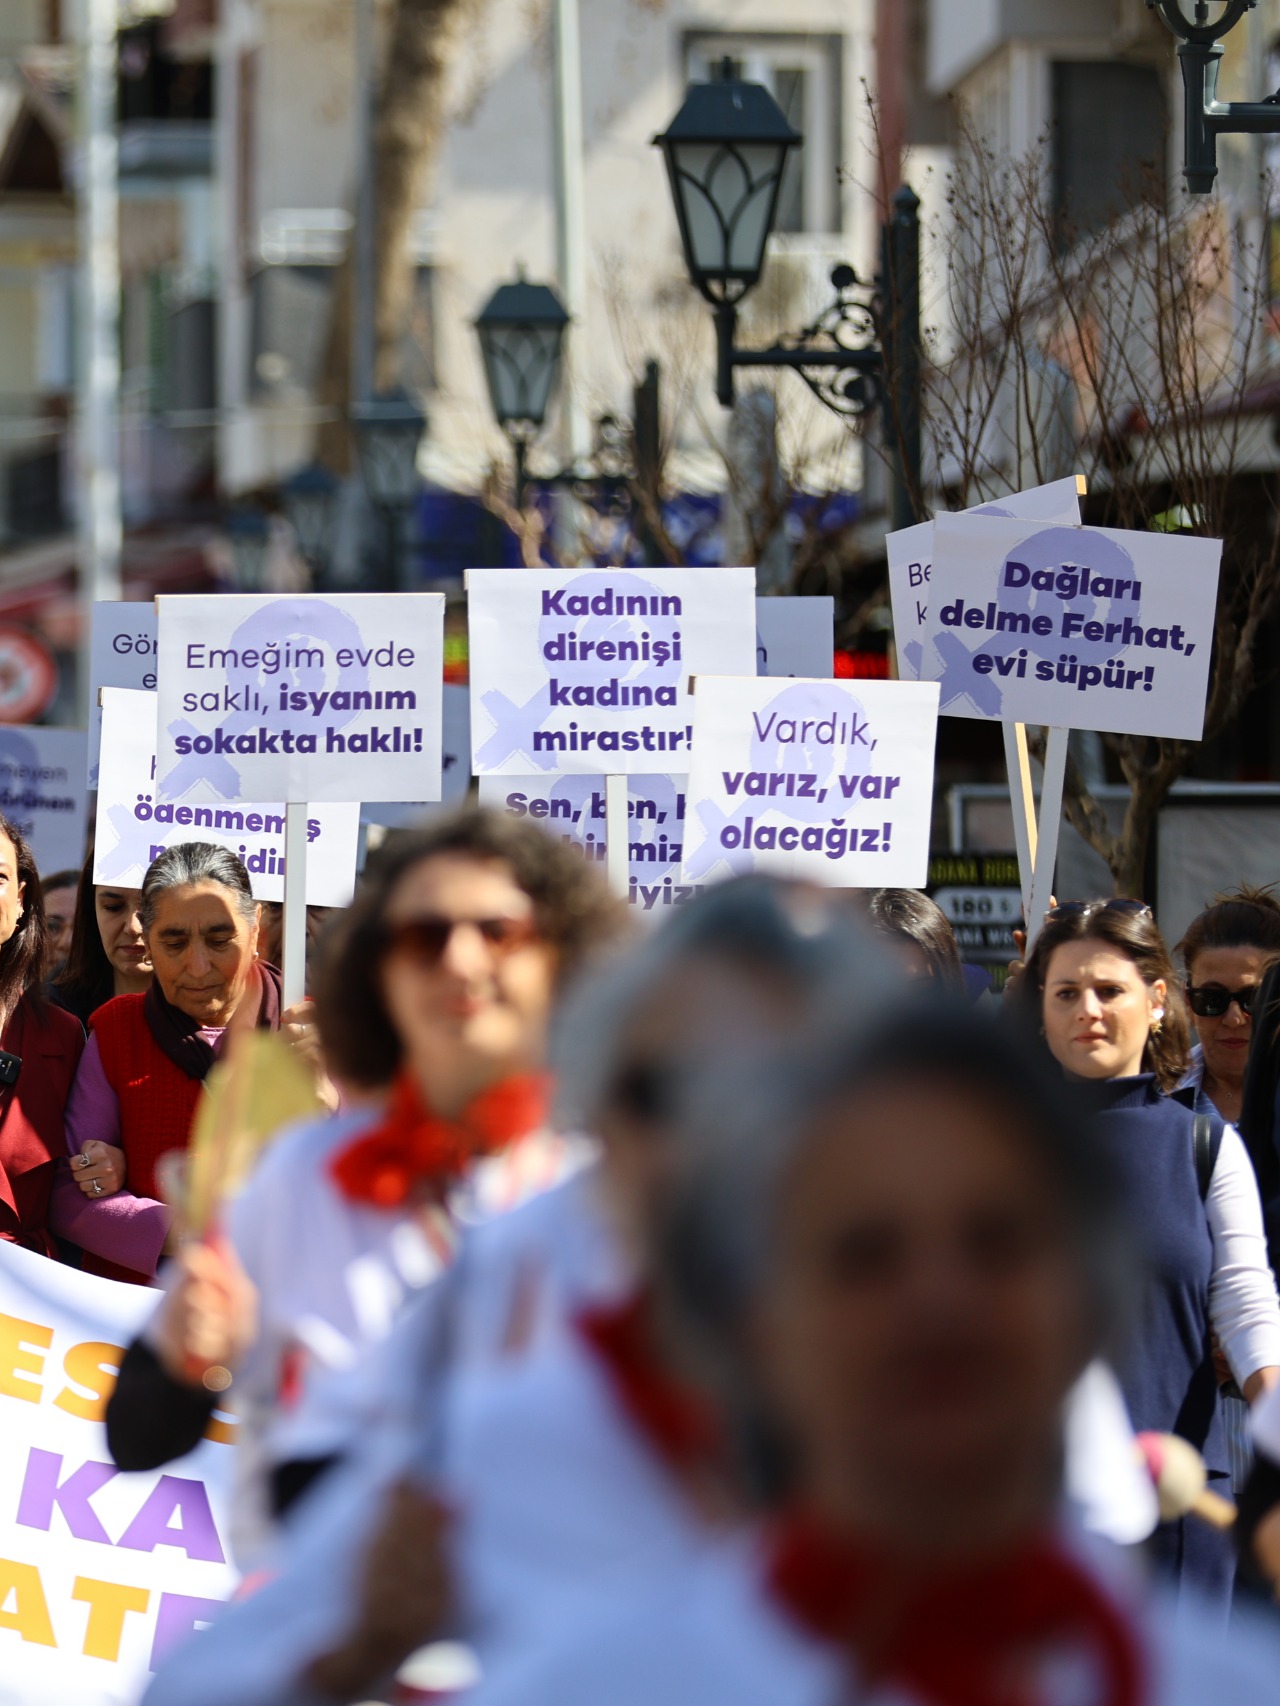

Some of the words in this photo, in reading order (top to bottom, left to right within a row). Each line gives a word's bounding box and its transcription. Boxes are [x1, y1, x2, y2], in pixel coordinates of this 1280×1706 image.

[1003, 561, 1143, 601] Dağları
[541, 588, 682, 616] Kadının
[939, 599, 1053, 636] delme
[1061, 612, 1196, 657] Ferhat,
[186, 642, 325, 675] Emeğim
[335, 641, 416, 668] evde
[543, 631, 682, 667] direnişi
[972, 649, 1029, 678] evi
[1035, 654, 1155, 692] süpür!
[182, 684, 270, 716] saklı,
[279, 682, 417, 716] isyanım
[549, 678, 677, 706] kadına
[174, 727, 317, 755] sokakta
[325, 727, 423, 753] haklı!
[532, 722, 692, 752] mirastır!
[753, 711, 879, 752] Vardık,
[723, 770, 827, 804] varız,
[839, 774, 900, 800] var
[134, 794, 321, 842] ödenmemş
[505, 792, 582, 823] Sen,
[720, 817, 892, 860] olacağız!
